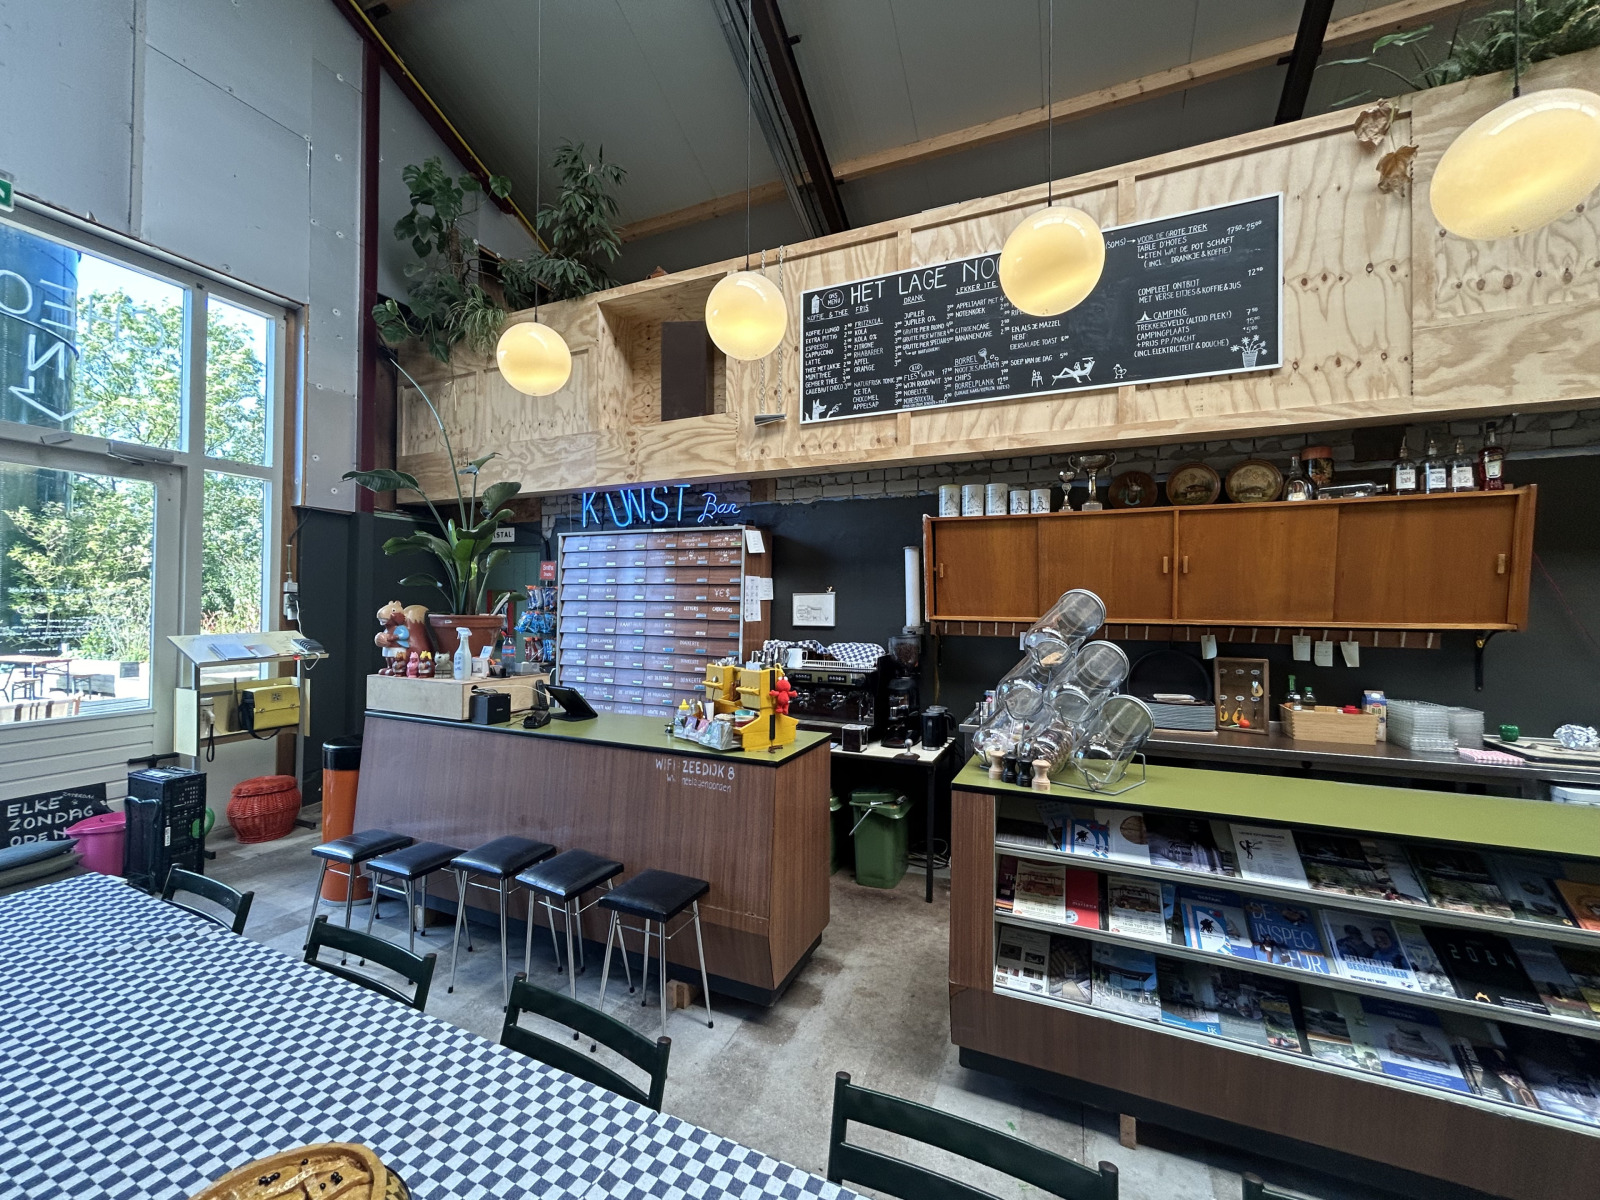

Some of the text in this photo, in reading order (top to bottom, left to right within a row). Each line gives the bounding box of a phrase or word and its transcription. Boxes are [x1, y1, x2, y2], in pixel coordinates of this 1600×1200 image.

[1137, 224, 1208, 245] VOOR DE GROTE TREK
[1137, 242, 1156, 252] TABLE
[1144, 250, 1162, 259] ETEN
[1180, 245, 1188, 254] DE
[1192, 242, 1204, 251] POT
[1207, 236, 1235, 248] SCHAFT
[1170, 252, 1200, 264] DRANKJE
[850, 280, 885, 305] HET
[898, 266, 947, 295] LAGE
[956, 284, 980, 294] LEKKER
[1138, 279, 1200, 296] COMPLEET ONTBIJT
[904, 294, 924, 304] DRANK
[1138, 295, 1152, 304] MET
[1156, 292, 1174, 302] VERSE
[855, 304, 870, 313] FRIS
[956, 299, 986, 310] APPELTAART
[834, 308, 849, 317] THEE
[904, 310, 925, 320] JUPILER
[956, 308, 986, 318] NOTENKOEK
[1153, 308, 1187, 320] CAMPING
[904, 317, 926, 326] JUPILER
[1021, 324, 1031, 332] ALS
[1039, 320, 1061, 328] MAZZEL
[1136, 318, 1184, 332] TREKKERSVELD
[854, 328, 868, 336] KOLA
[955, 322, 990, 334] CITROENCAKE
[1136, 326, 1190, 341] CAMPINGPLAATS
[806, 336, 820, 344] EXTRA
[955, 331, 992, 342] BANANENCAKE
[806, 342, 828, 352] ESPRESSO
[854, 342, 874, 350] ZITRONE
[1010, 337, 1058, 350] EIERSALADE TOAST
[1152, 342, 1194, 356] ELEKTRICITEIT
[805, 349, 834, 358] CAPPUCCINO
[854, 348, 884, 358] RHABARBER
[806, 358, 821, 366] LATTE
[854, 358, 869, 366] APFEL
[954, 355, 978, 366] BORREL
[854, 364, 876, 373] ORANGE
[805, 377, 838, 388] GEMBER THEE
[904, 373, 918, 381] FLES
[955, 373, 972, 382] CHIPS
[955, 379, 994, 390] BORRELPLANK
[904, 388, 928, 396] NOBELTJE
[852, 395, 879, 403] CHOCOMEL
[852, 402, 879, 410] APPELSAP
[582, 484, 741, 528] KUNST Bar
[682, 760, 725, 778] ZEEDIJK
[728, 766, 735, 780] 8
[7, 796, 63, 817] ELKE
[8, 805, 94, 832] ZONDAG
[10, 827, 67, 847] OPEN
[1255, 923, 1315, 950] INSPEC
[1346, 962, 1408, 978] BESCHERMEN
